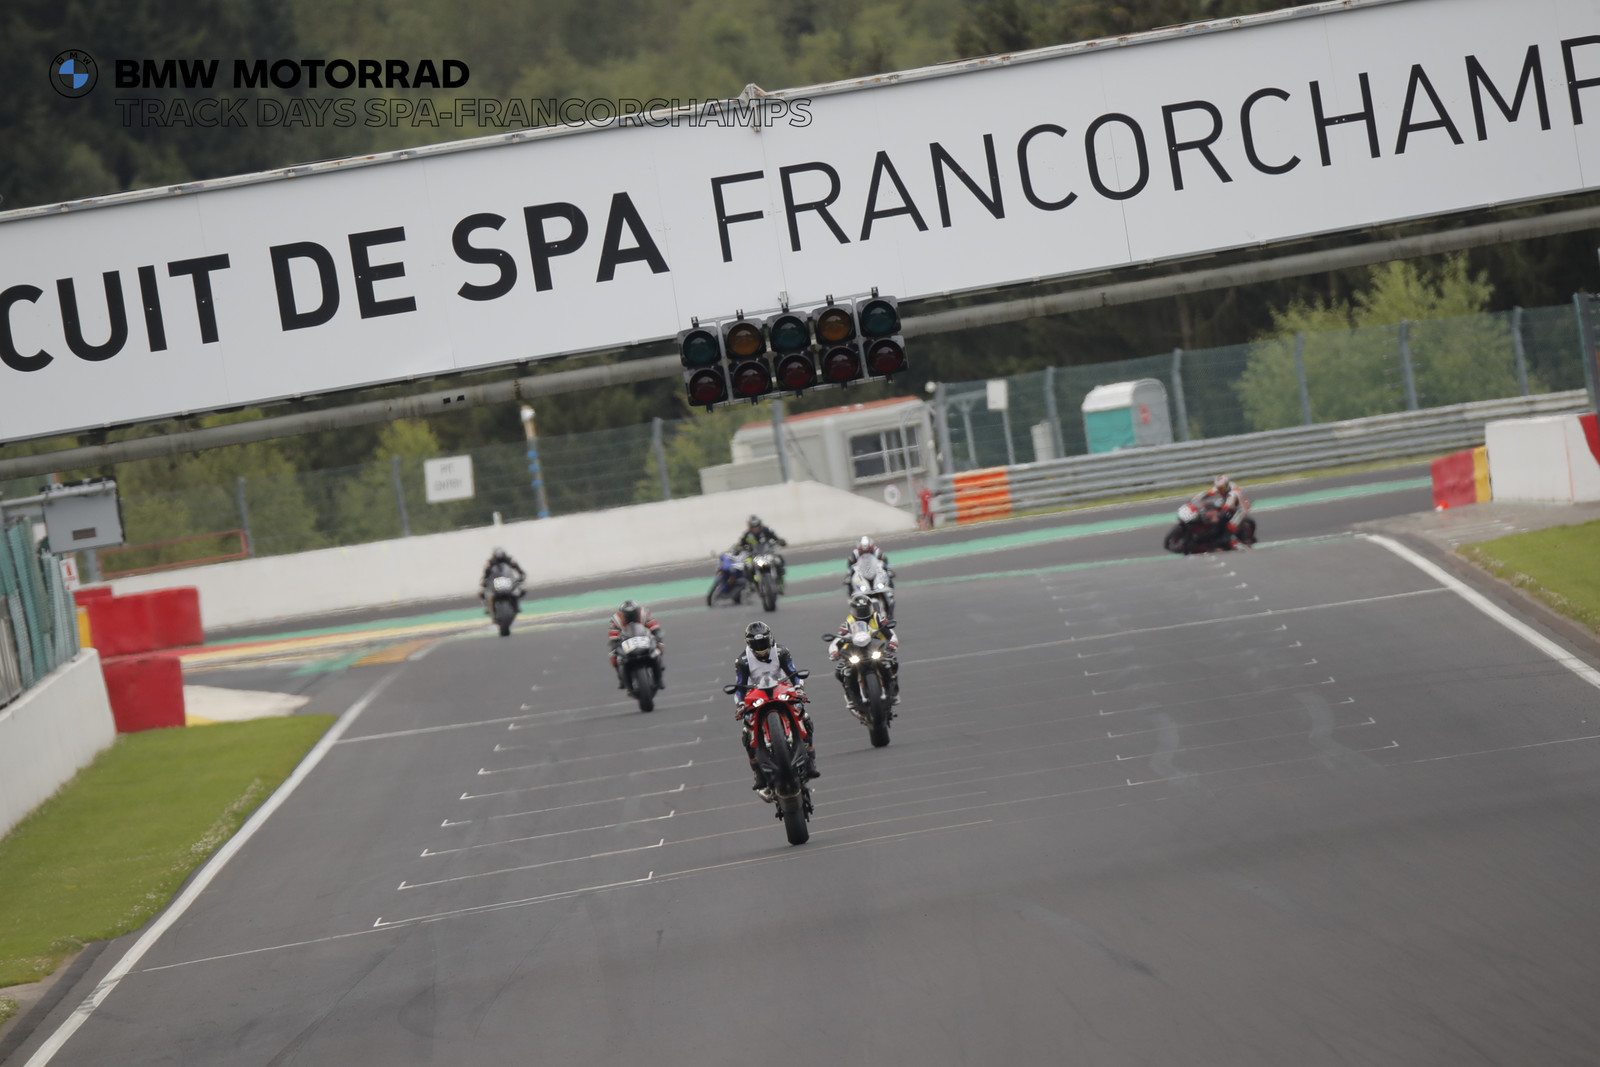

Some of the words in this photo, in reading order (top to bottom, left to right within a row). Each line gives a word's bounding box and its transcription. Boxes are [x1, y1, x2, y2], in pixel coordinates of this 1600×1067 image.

[0, 254, 230, 373] CUIT
[269, 227, 417, 332] DE
[452, 192, 670, 302] SPA
